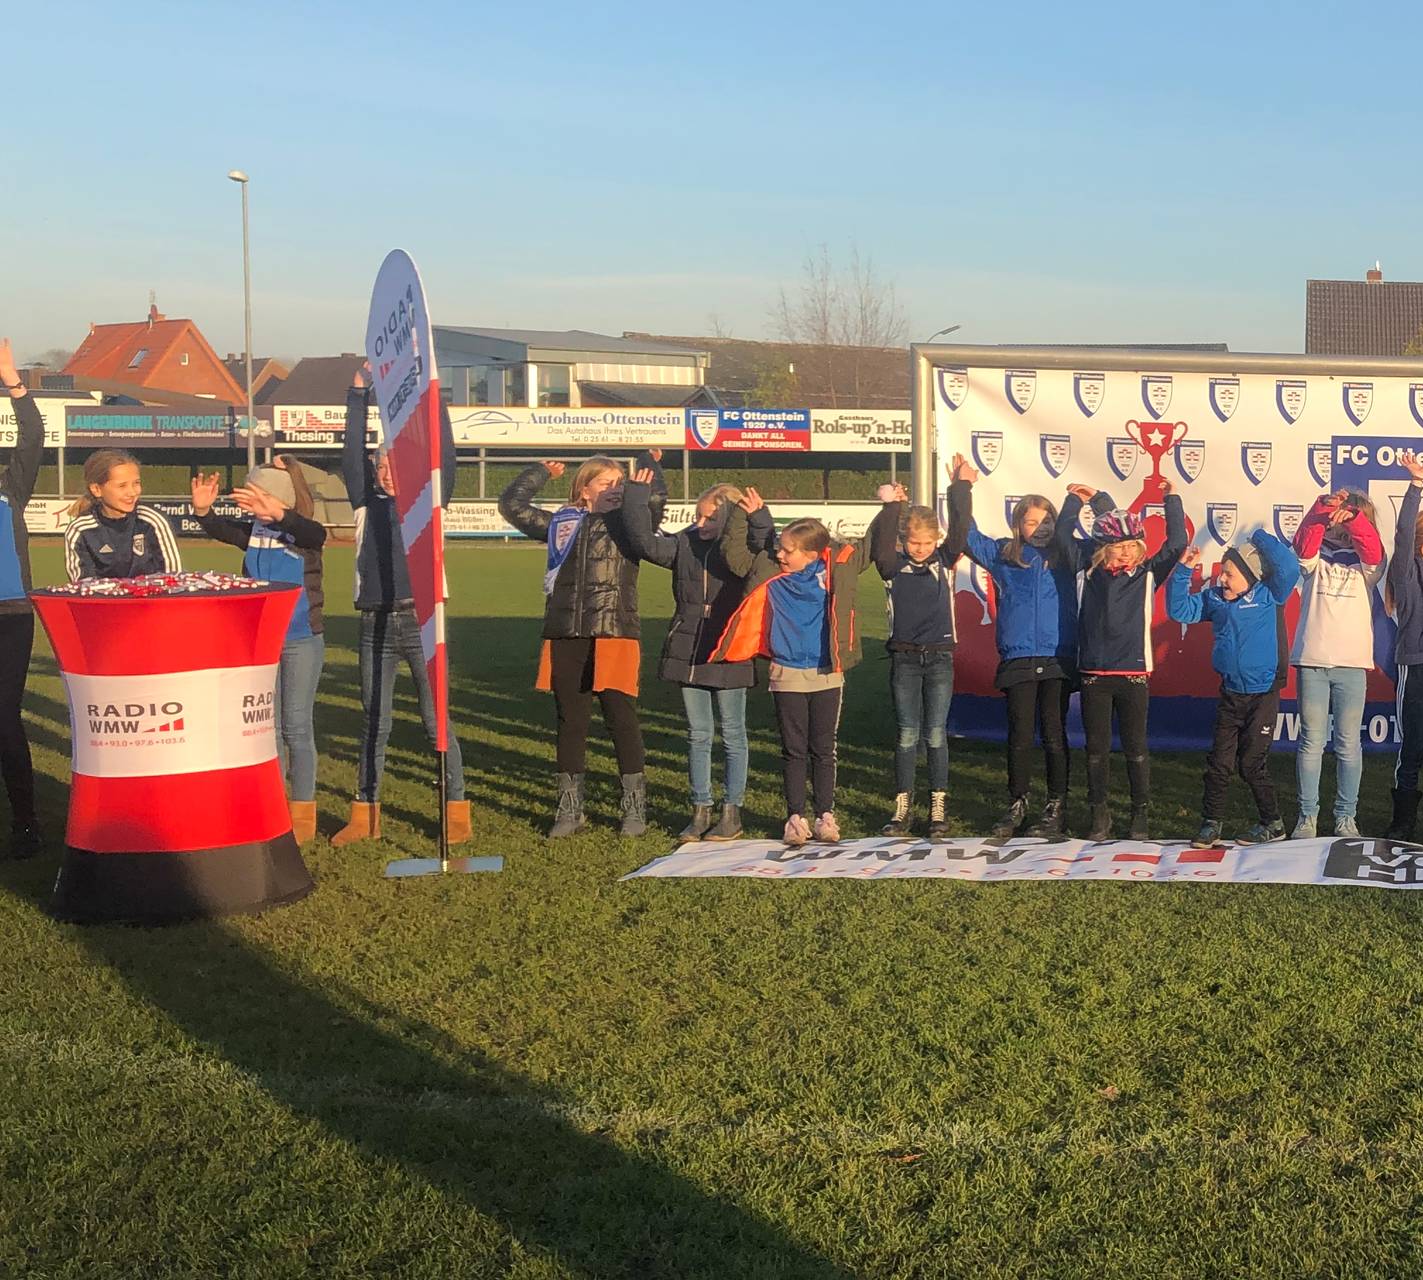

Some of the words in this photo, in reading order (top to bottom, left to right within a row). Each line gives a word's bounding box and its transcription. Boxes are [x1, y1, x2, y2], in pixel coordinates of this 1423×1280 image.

[156, 415, 224, 430] TRANSPORTE
[528, 412, 680, 425] Autohaus-Ottenstein
[723, 411, 739, 420] FC
[742, 412, 805, 421] Ottenstein
[283, 431, 334, 443] Thesing
[547, 426, 563, 434] Das
[565, 427, 601, 435] Autohaus
[604, 426, 623, 435] Ihres
[625, 427, 667, 435] Vertrauens
[722, 440, 752, 448] SEINEN
[868, 437, 911, 446] Abbing
[1336, 445, 1369, 465] FC
[88, 702, 183, 717] RADIO
[242, 708, 271, 723] WMW
[89, 720, 140, 733] WMW
[765, 848, 1030, 864] WMW
